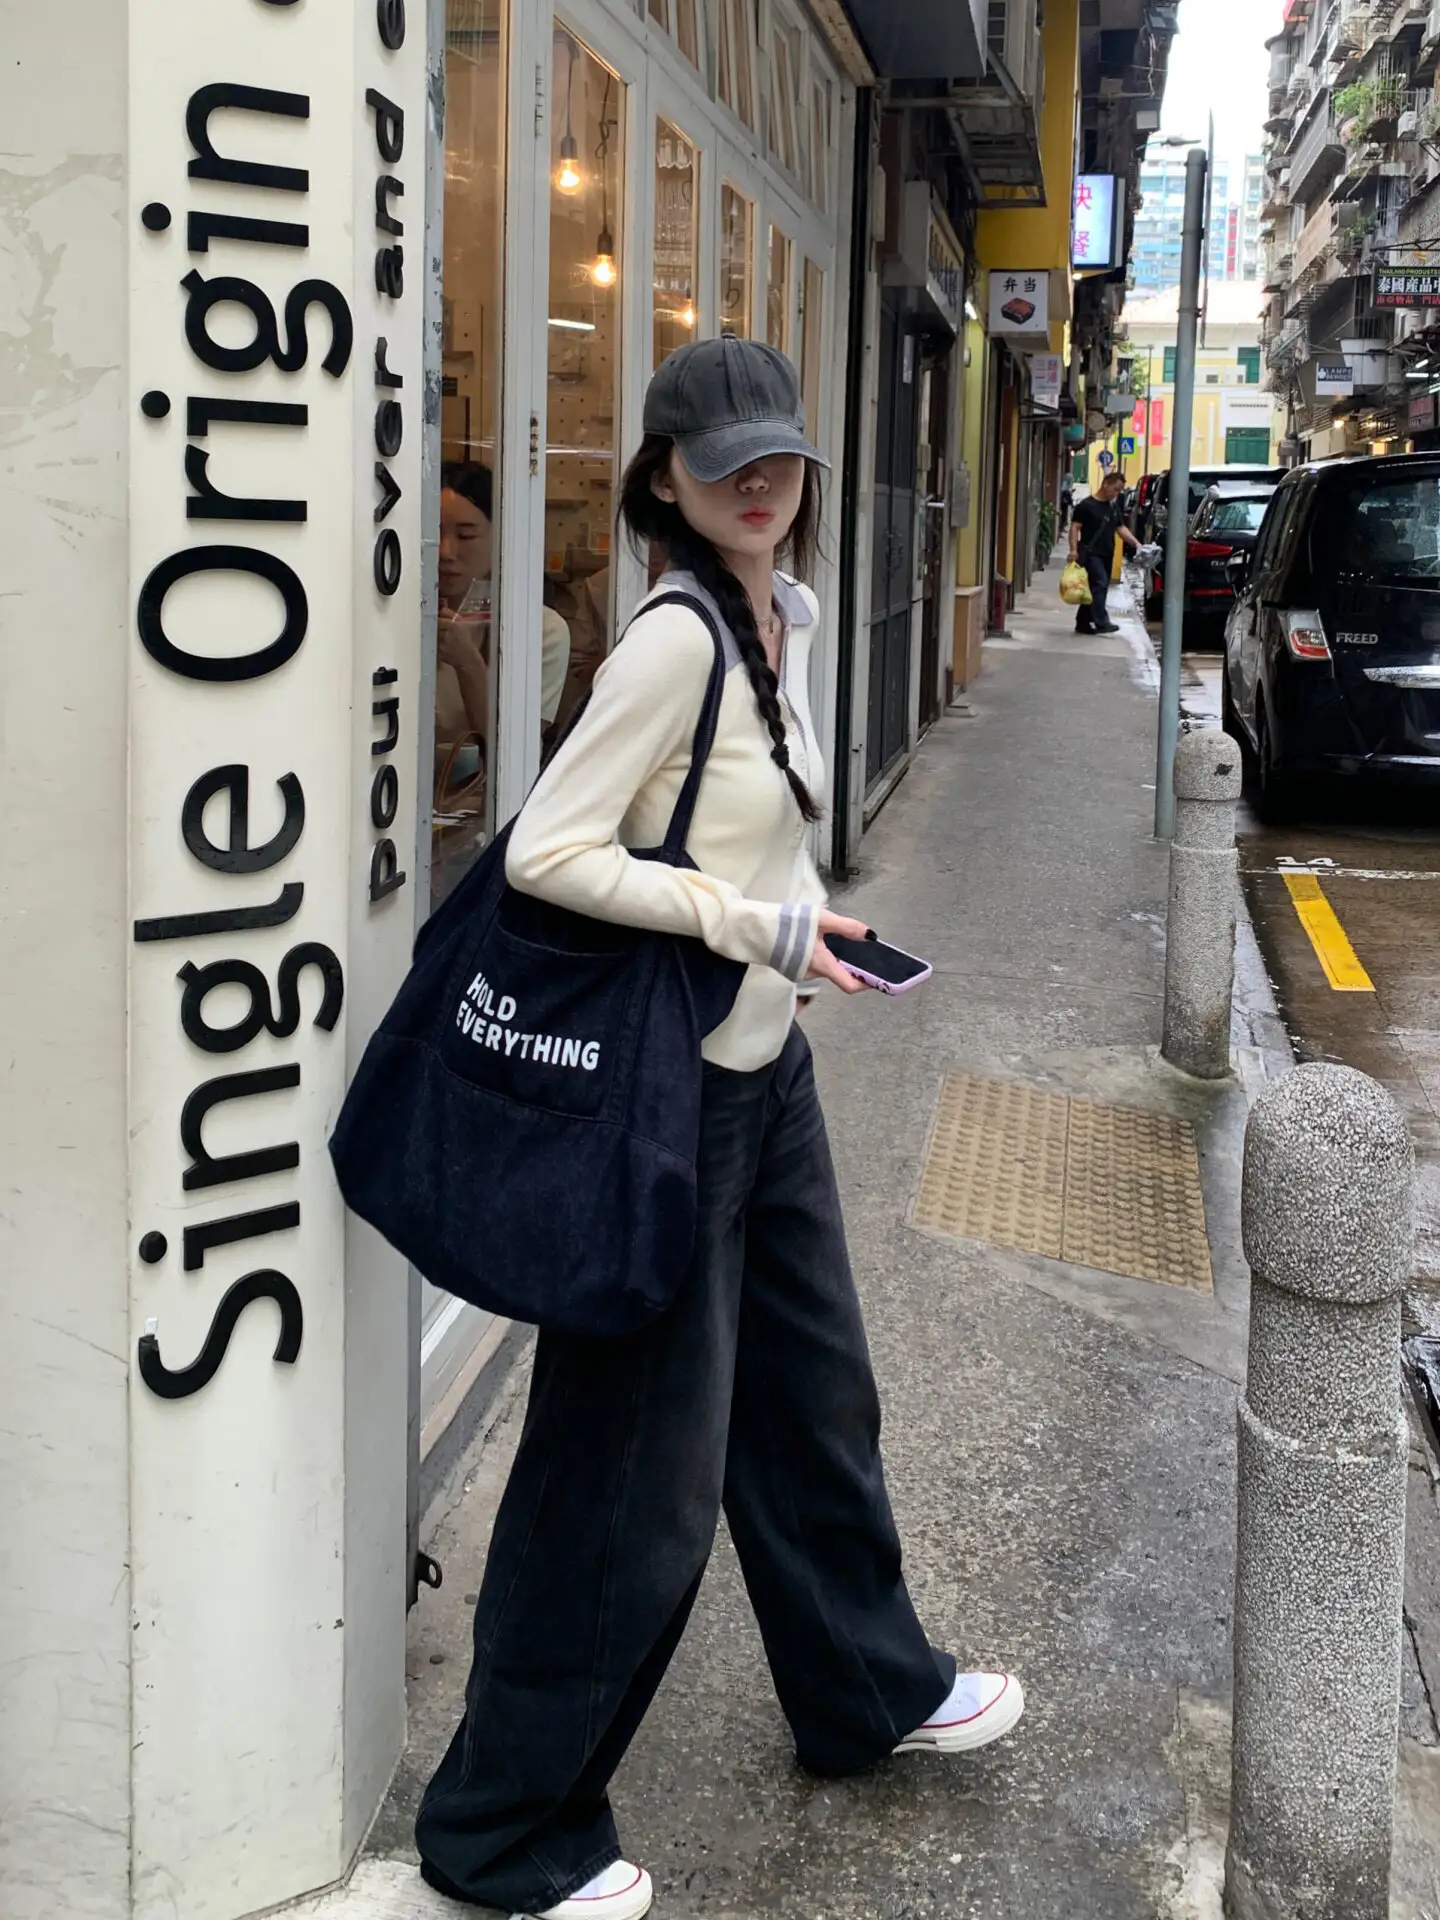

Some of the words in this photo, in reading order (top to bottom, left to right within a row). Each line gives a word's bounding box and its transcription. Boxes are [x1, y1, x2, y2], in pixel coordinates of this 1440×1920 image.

[366, 88, 404, 299] and
[1003, 277, 1036, 292] 弁当
[137, 83, 353, 682] Origin
[374, 337, 404, 596] over
[1336, 632, 1378, 644] FREED
[456, 1000, 600, 1070] EVERYTHING
[467, 972, 517, 1021] HOLD
[134, 764, 344, 1399] Single
